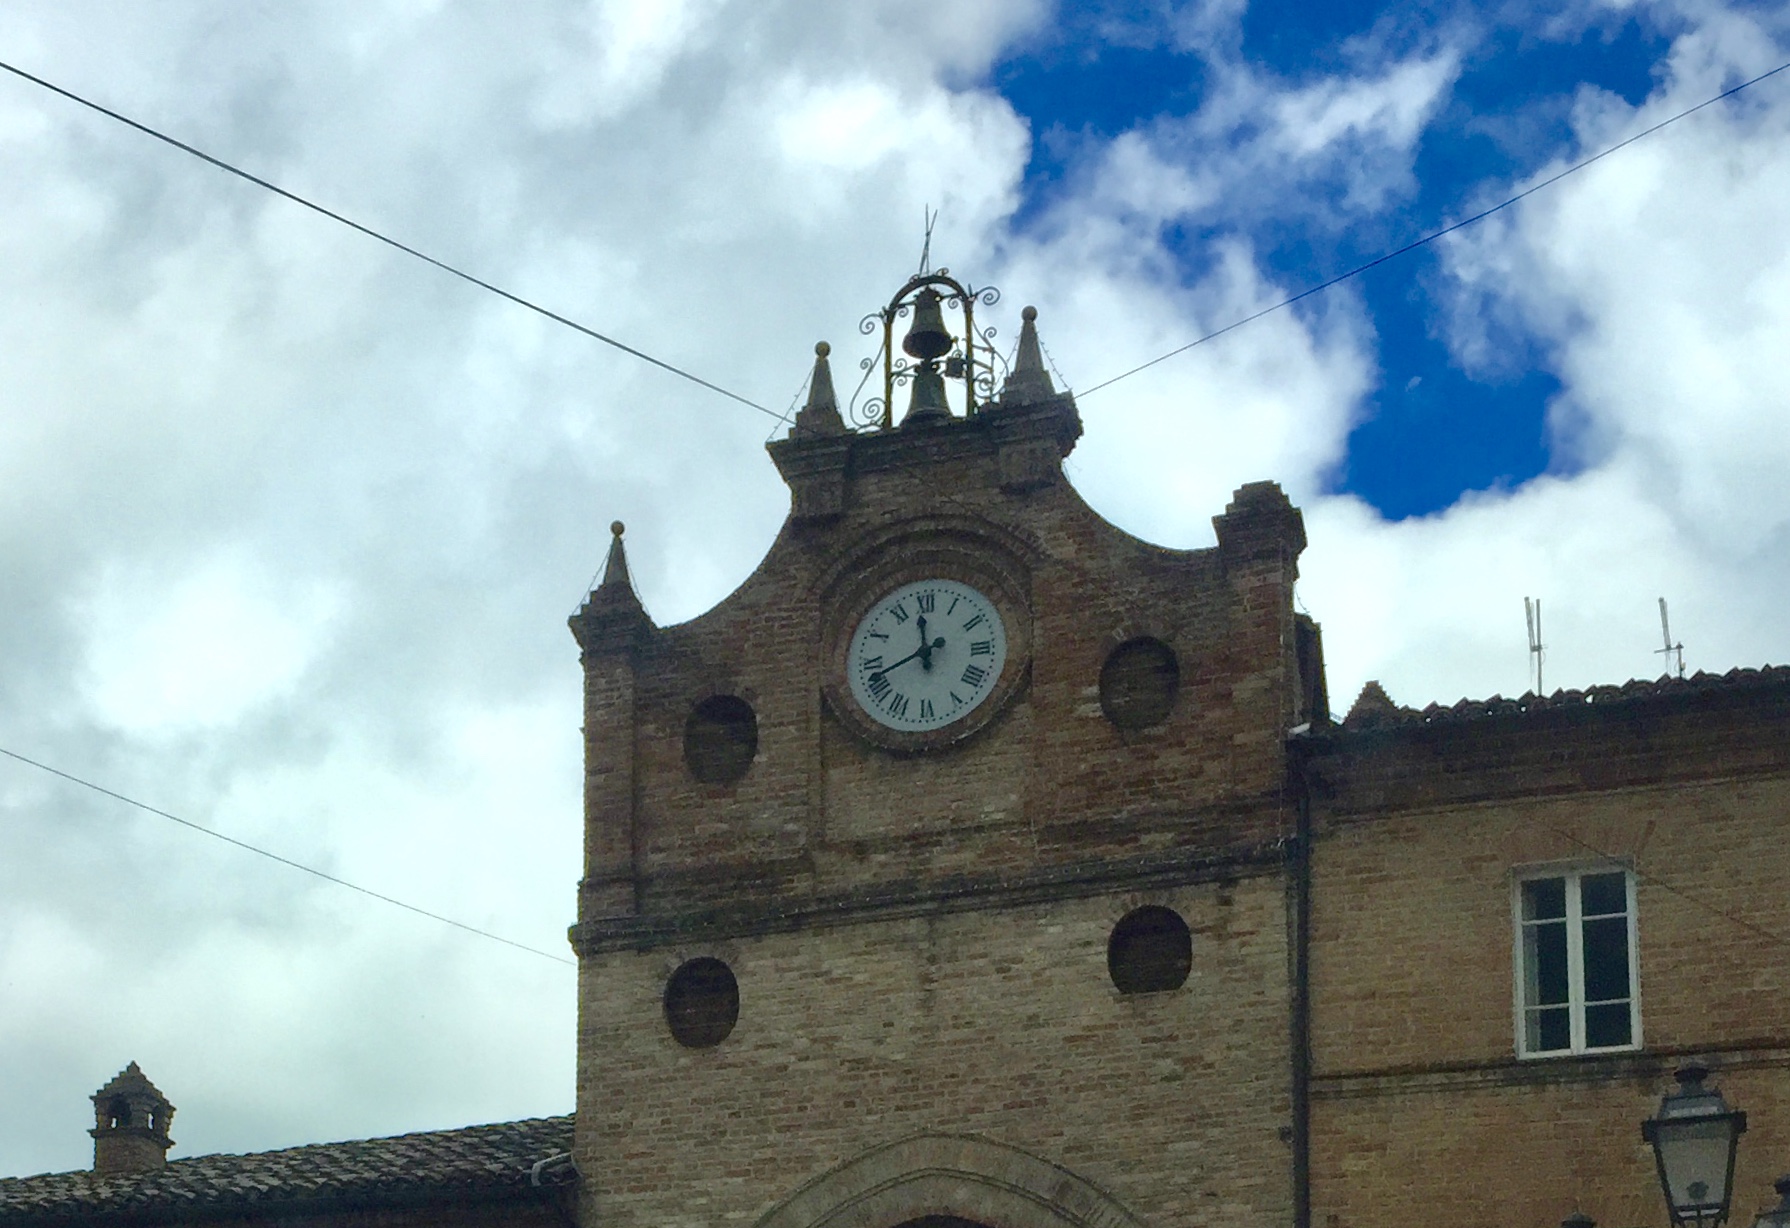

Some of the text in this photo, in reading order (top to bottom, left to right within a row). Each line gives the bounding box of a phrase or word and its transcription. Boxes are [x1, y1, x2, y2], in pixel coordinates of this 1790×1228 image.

[916, 593, 935, 614] XII
[947, 597, 959, 616] I
[963, 614, 983, 632] II
[971, 640, 991, 656] III
[961, 664, 985, 687] IIII
[920, 699, 935, 718] VI
